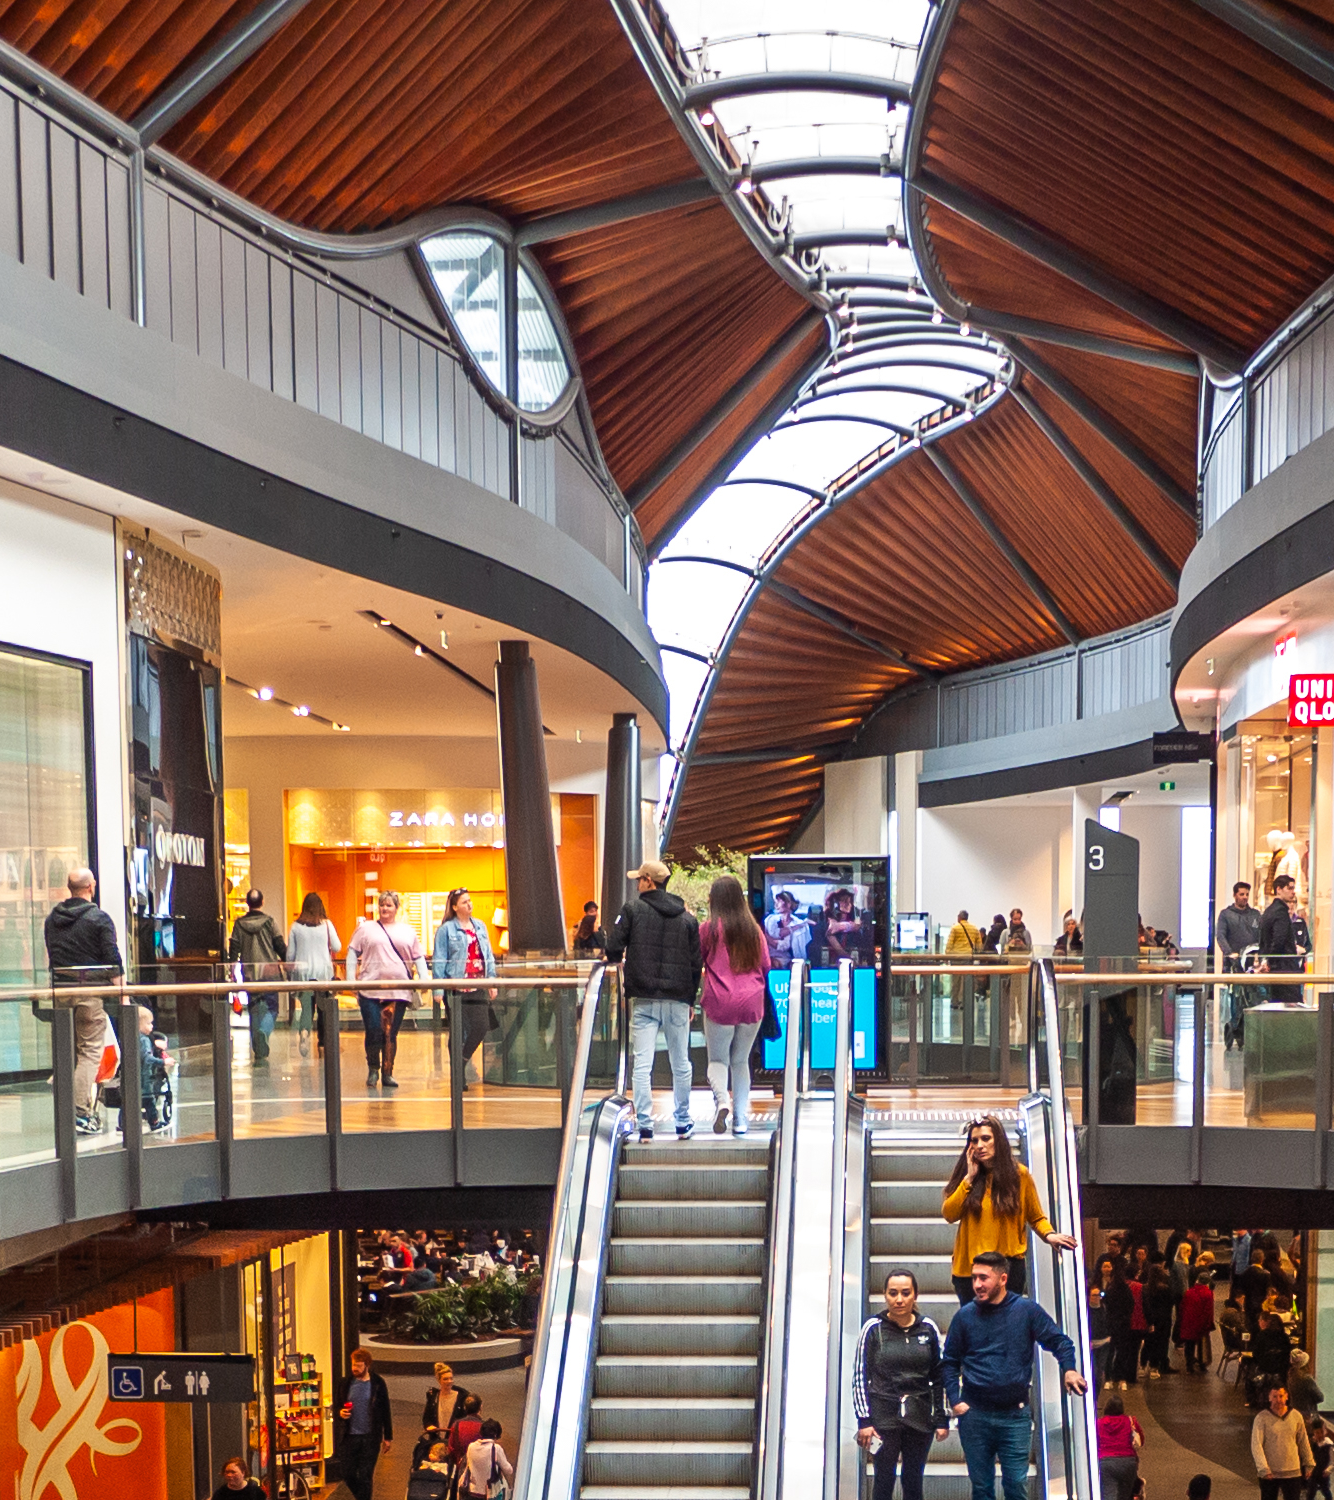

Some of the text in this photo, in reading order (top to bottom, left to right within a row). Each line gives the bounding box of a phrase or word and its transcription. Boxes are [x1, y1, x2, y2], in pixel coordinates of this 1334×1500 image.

[1295, 679, 1333, 698] UNI
[389, 812, 504, 827] ZARA HO
[1088, 844, 1105, 871] 3
